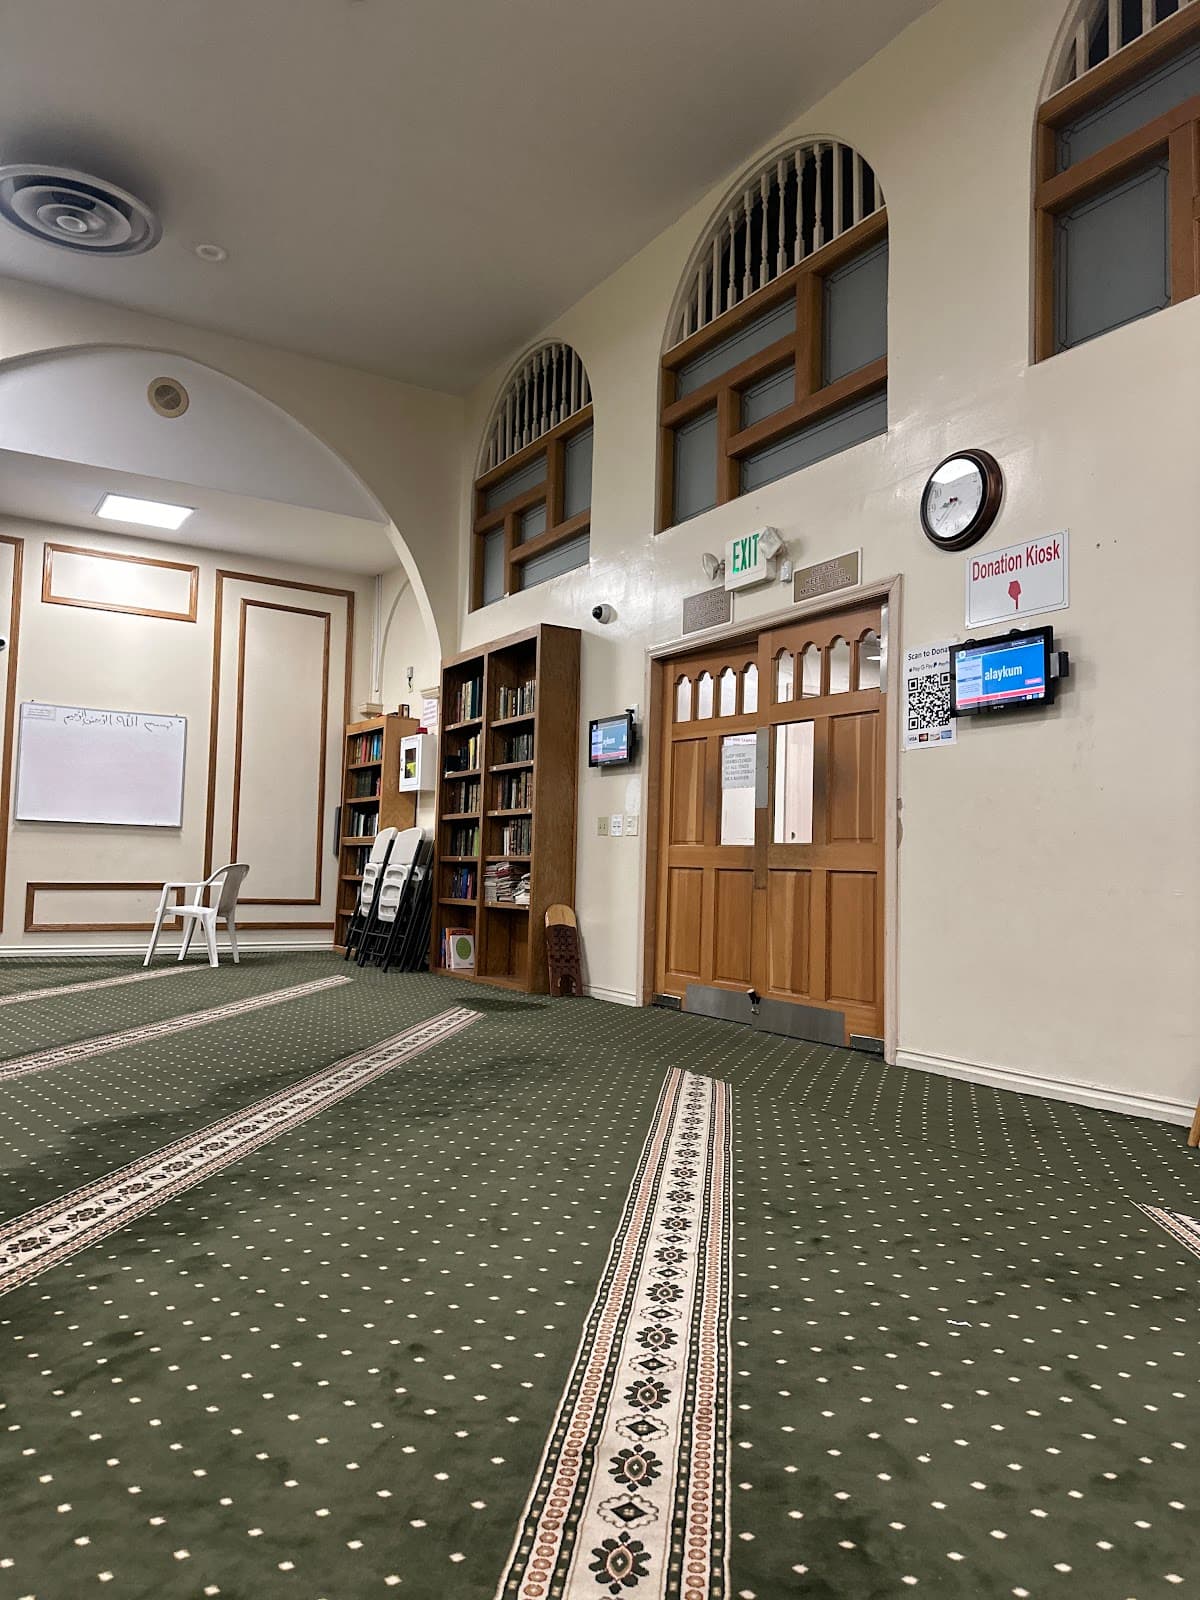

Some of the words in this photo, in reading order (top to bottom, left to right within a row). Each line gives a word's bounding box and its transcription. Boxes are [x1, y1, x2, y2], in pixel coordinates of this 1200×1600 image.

[732, 533, 760, 574] EXIT
[973, 553, 1022, 582] Donation
[1026, 540, 1060, 567] Kiosk
[908, 653, 922, 661] Scan
[932, 647, 948, 655] Dona
[985, 665, 1023, 681] alaykum
[116, 714, 138, 727] الله
